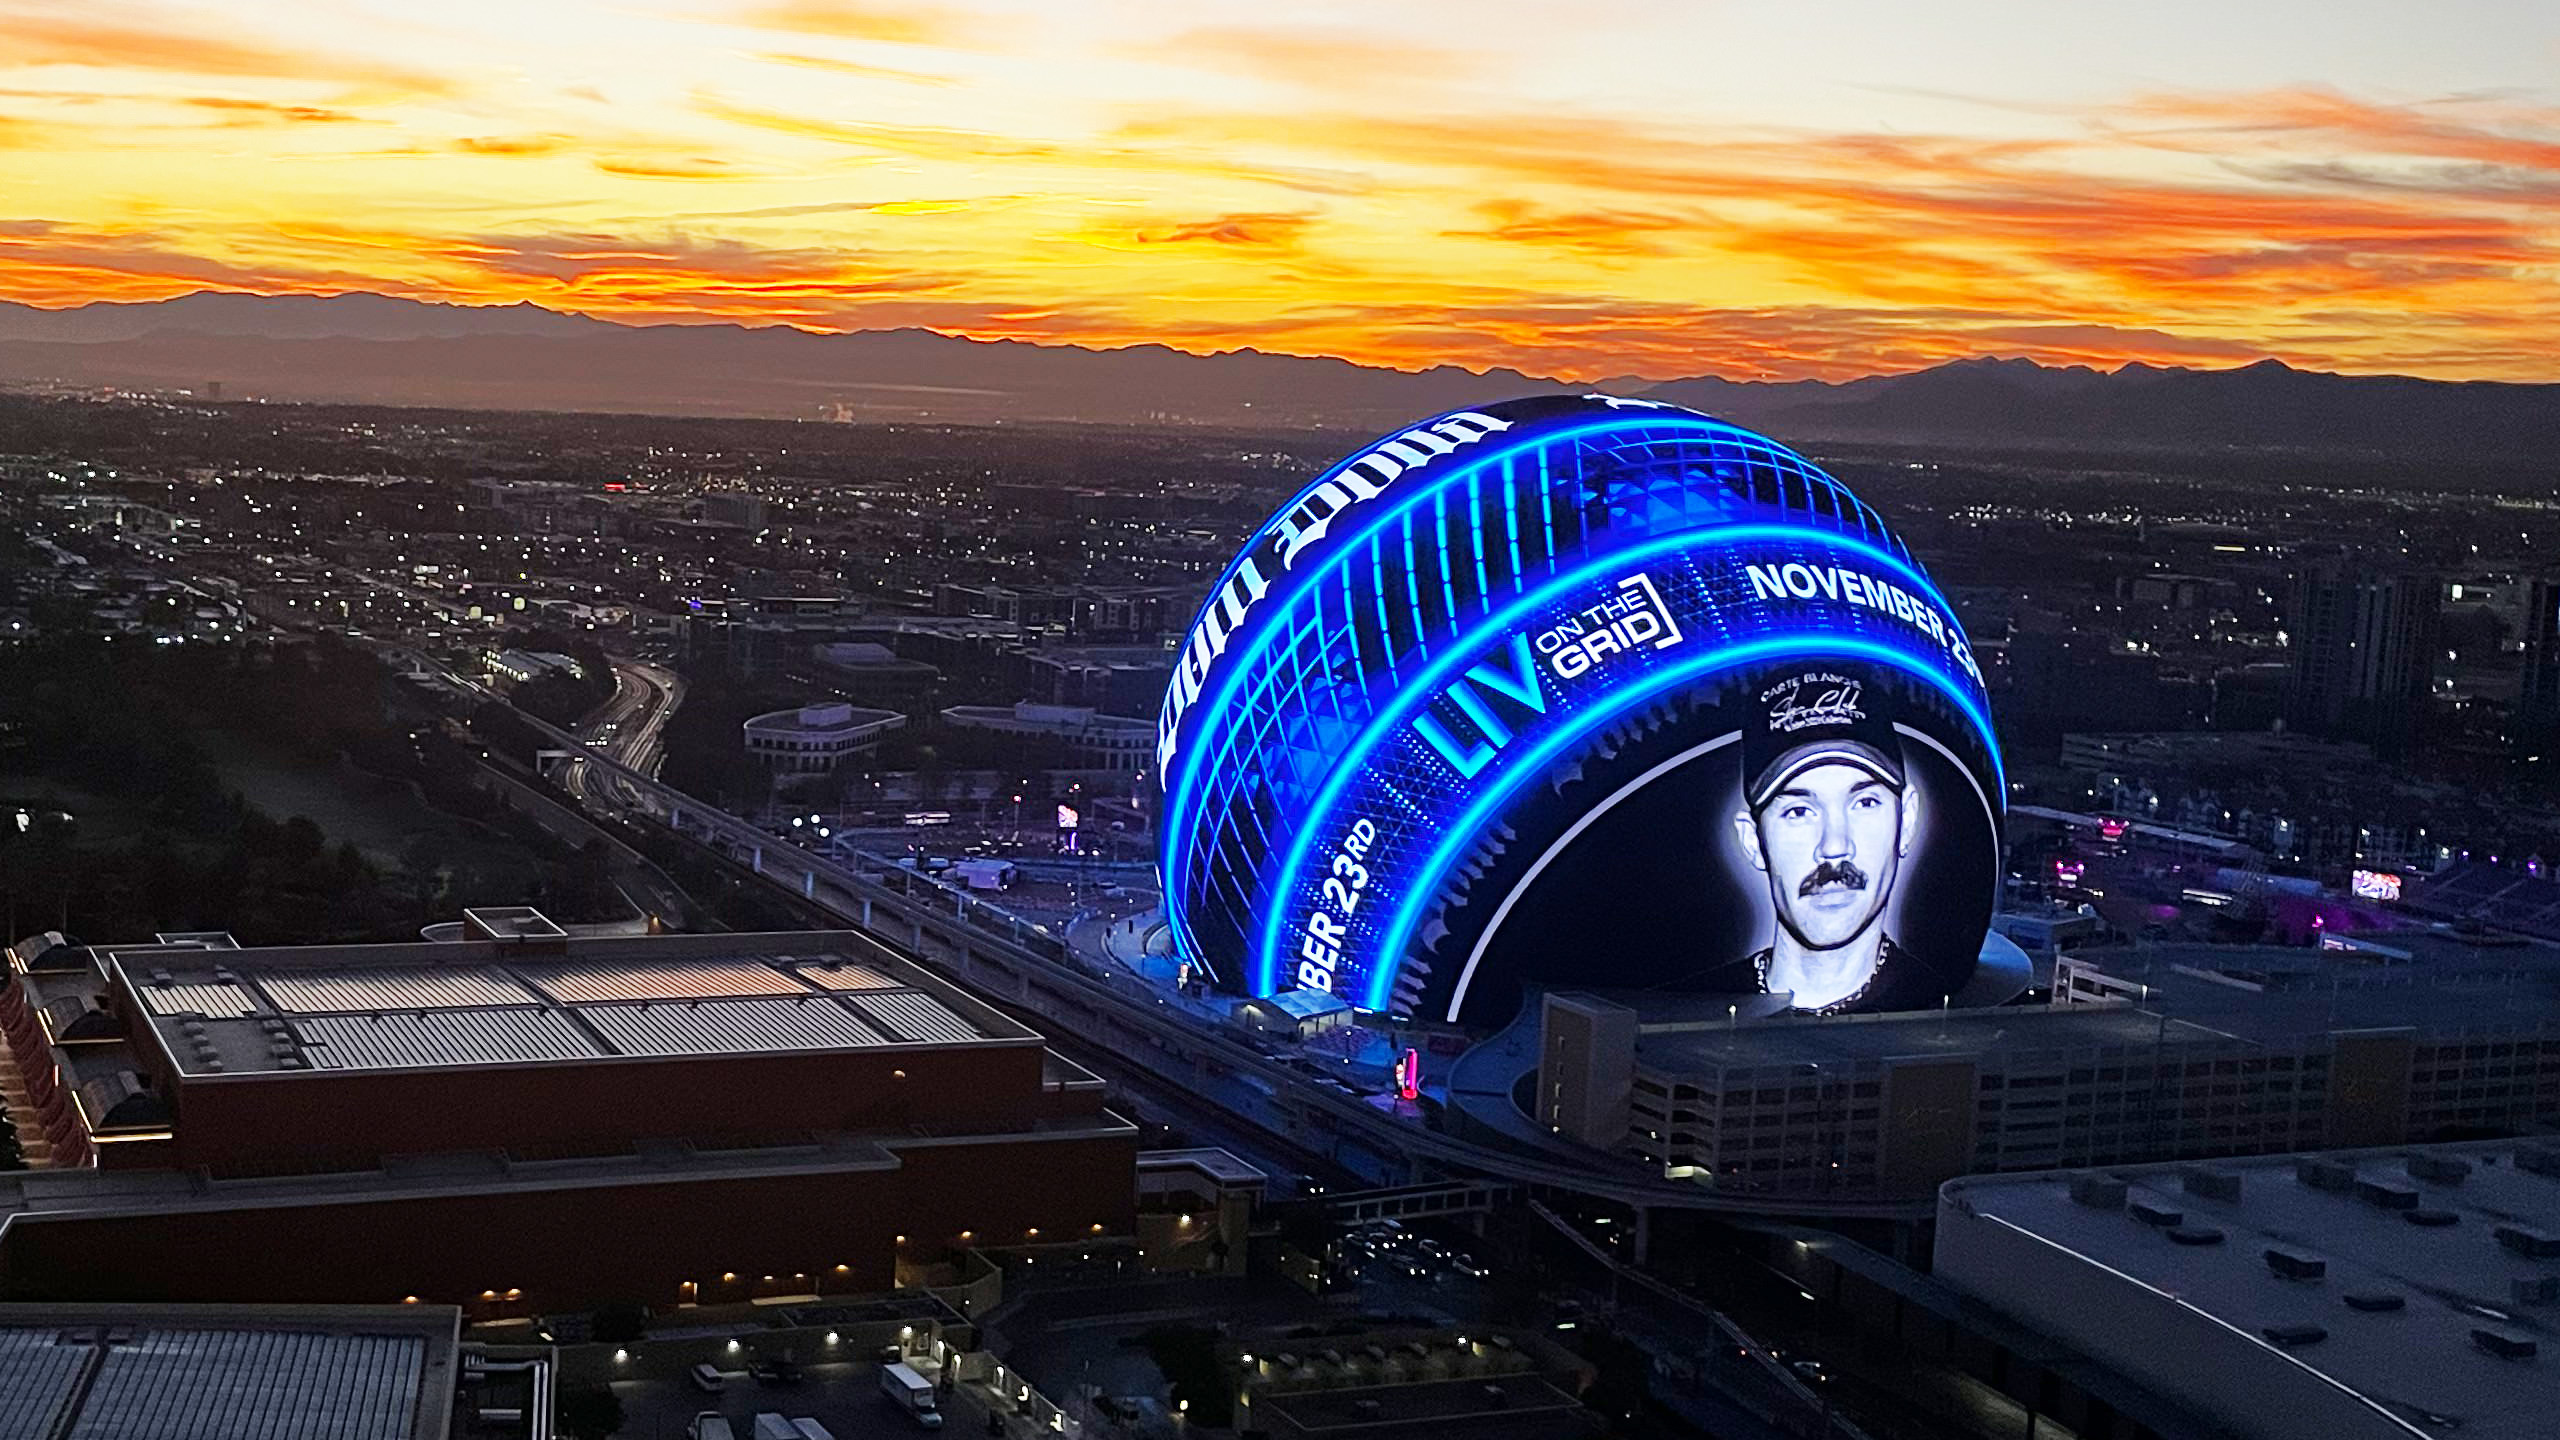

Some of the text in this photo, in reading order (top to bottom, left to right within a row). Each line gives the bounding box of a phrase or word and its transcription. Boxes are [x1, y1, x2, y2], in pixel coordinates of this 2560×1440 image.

[1536, 588, 1647, 654] ON THE
[1552, 611, 1661, 679] GRID
[1746, 563, 1947, 647] NOVEMBER
[1412, 632, 1546, 780] LIV
[1297, 818, 1375, 993] BER 23RD
